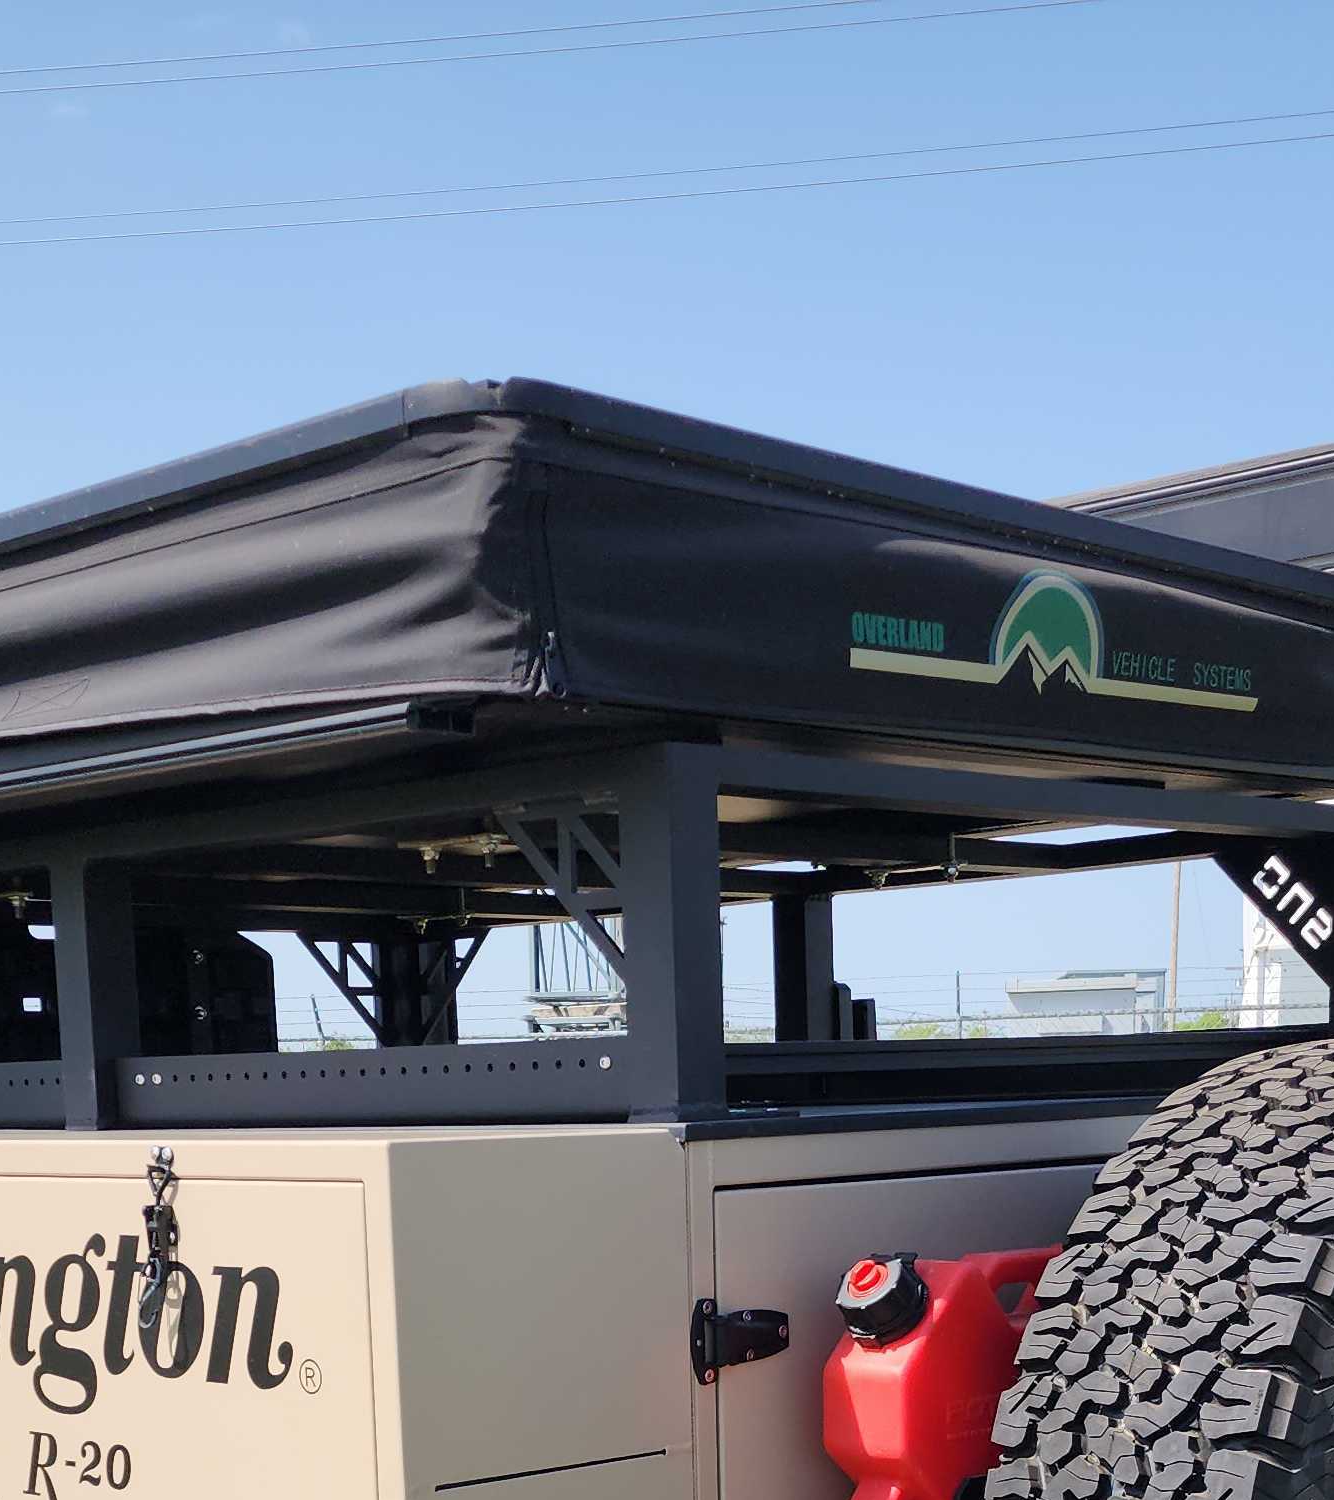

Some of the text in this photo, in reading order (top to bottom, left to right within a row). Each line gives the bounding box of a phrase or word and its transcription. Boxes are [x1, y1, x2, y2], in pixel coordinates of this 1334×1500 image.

[850, 610, 945, 652] OVERLAND
[1111, 649, 1253, 692] VEHICLE SYSTEMS
